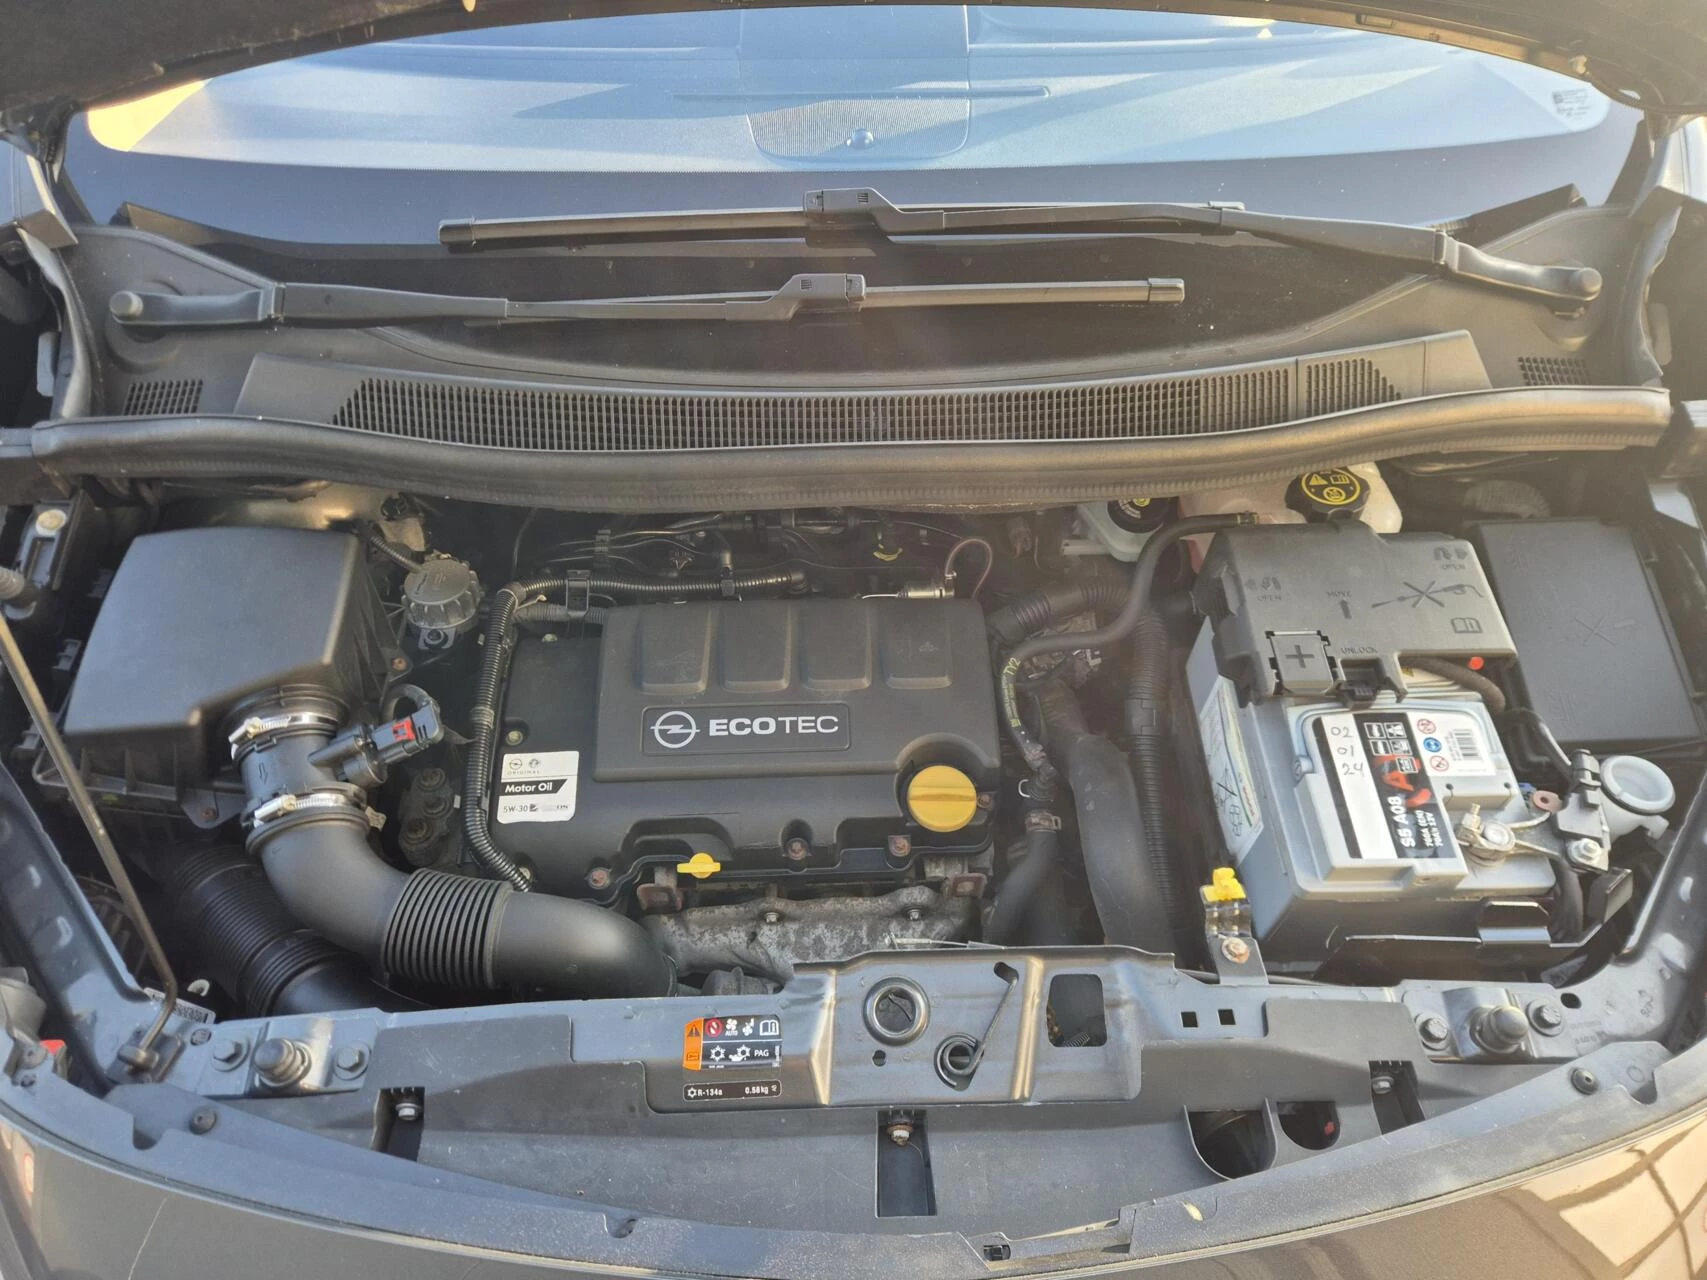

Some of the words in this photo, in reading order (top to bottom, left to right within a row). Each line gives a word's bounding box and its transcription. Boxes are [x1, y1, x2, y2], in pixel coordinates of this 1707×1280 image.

[1340, 647, 1378, 655] UNLOCK
[709, 715, 839, 737] ECOTEC
[1330, 726, 1353, 738] 02
[1337, 744, 1355, 757] 01
[1341, 761, 1364, 777] 24
[505, 784, 536, 793] Motor
[538, 782, 553, 791] Oil
[503, 804, 529, 813] 5W-30
[1387, 795, 1409, 826] A08
[754, 1049, 769, 1057] PAG
[697, 1088, 723, 1097] R-134a
